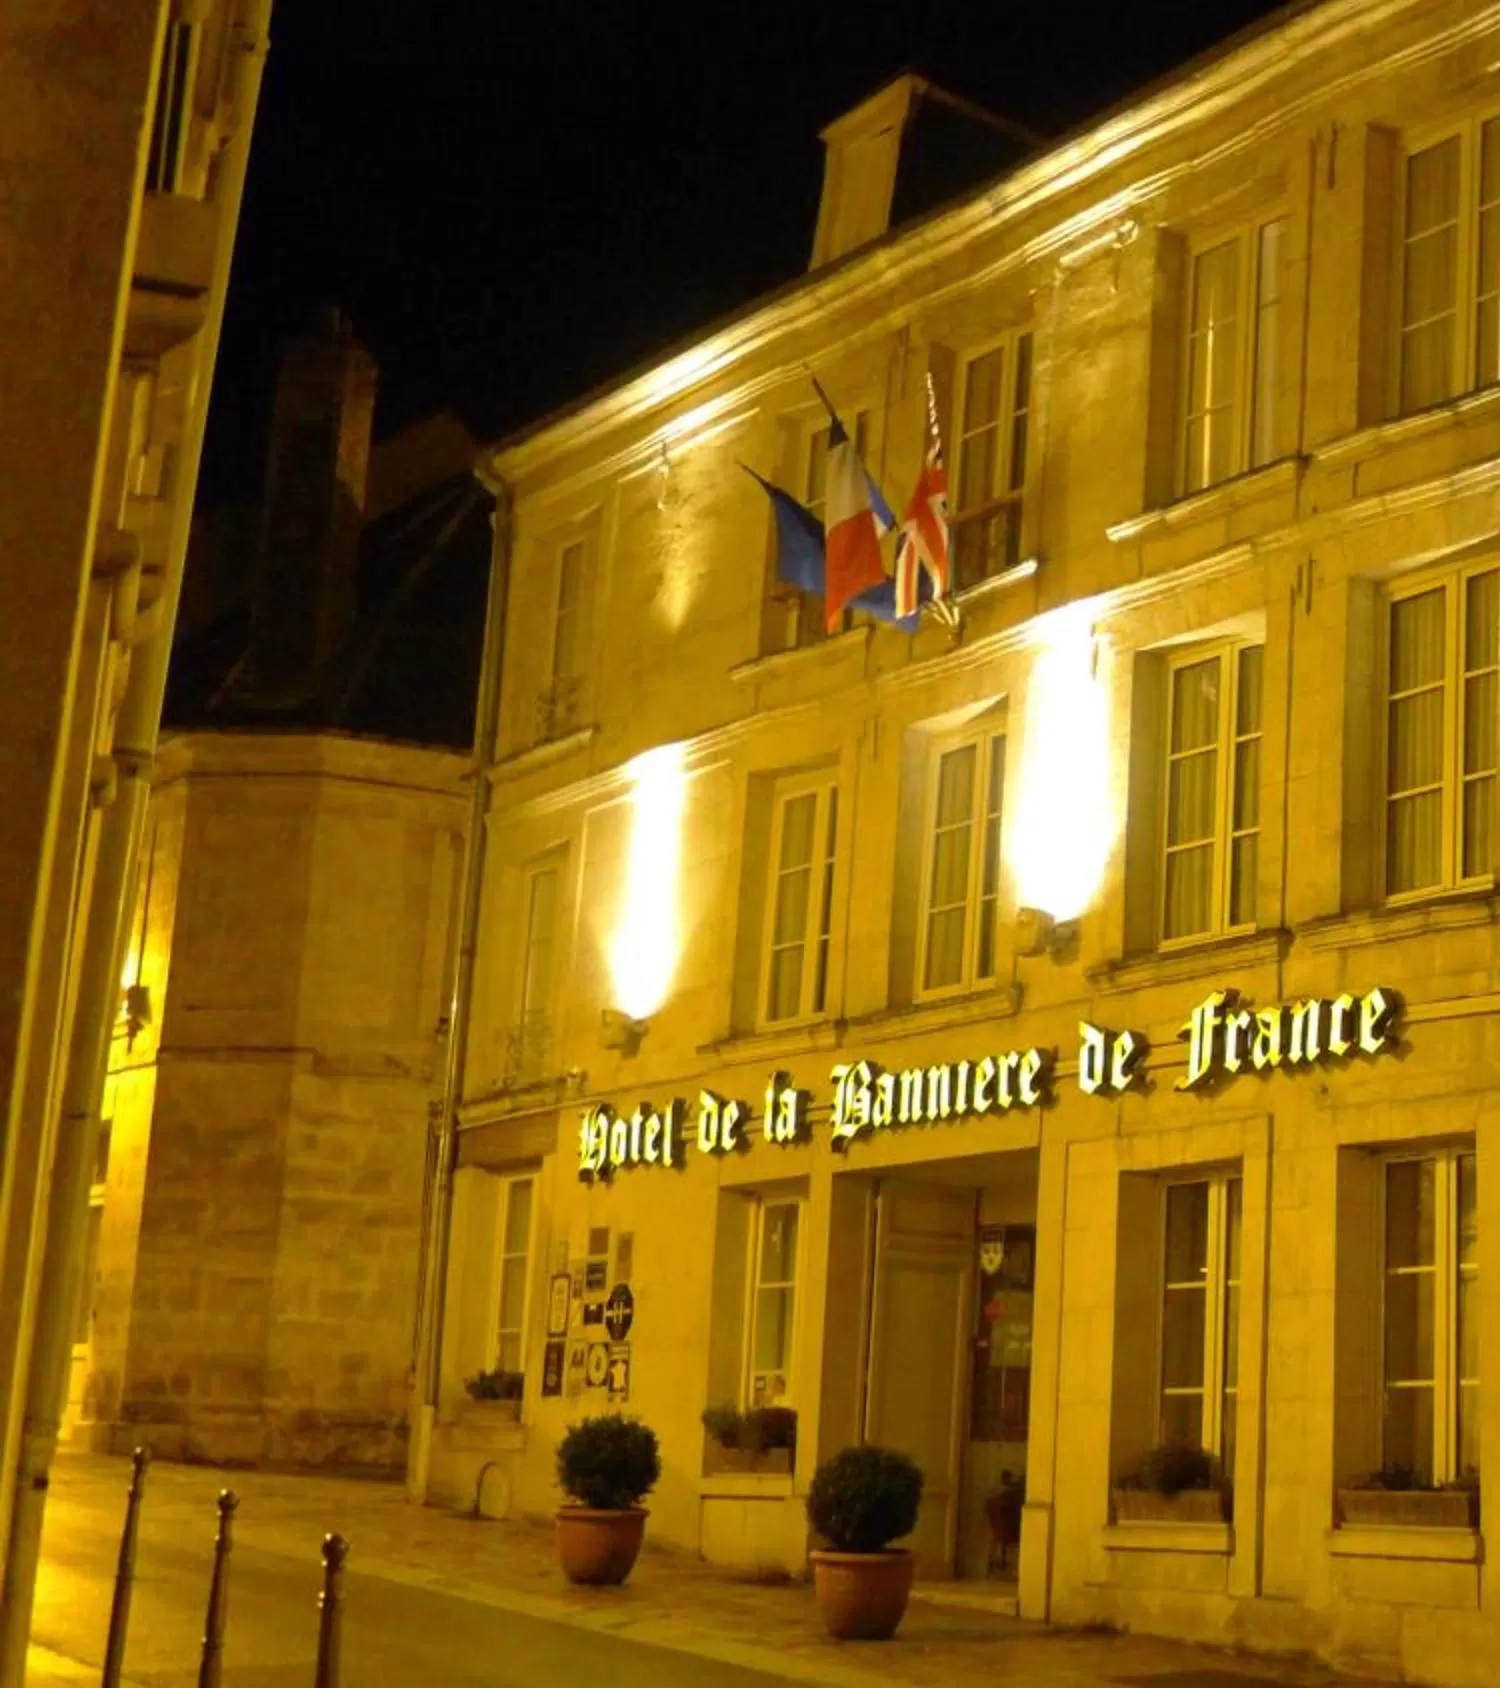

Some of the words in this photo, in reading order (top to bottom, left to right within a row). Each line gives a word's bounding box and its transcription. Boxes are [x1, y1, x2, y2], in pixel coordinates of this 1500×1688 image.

[697, 1088, 740, 1153] de
[763, 1071, 798, 1142] la
[1079, 1021, 1135, 1094] de
[1174, 988, 1387, 1090] France
